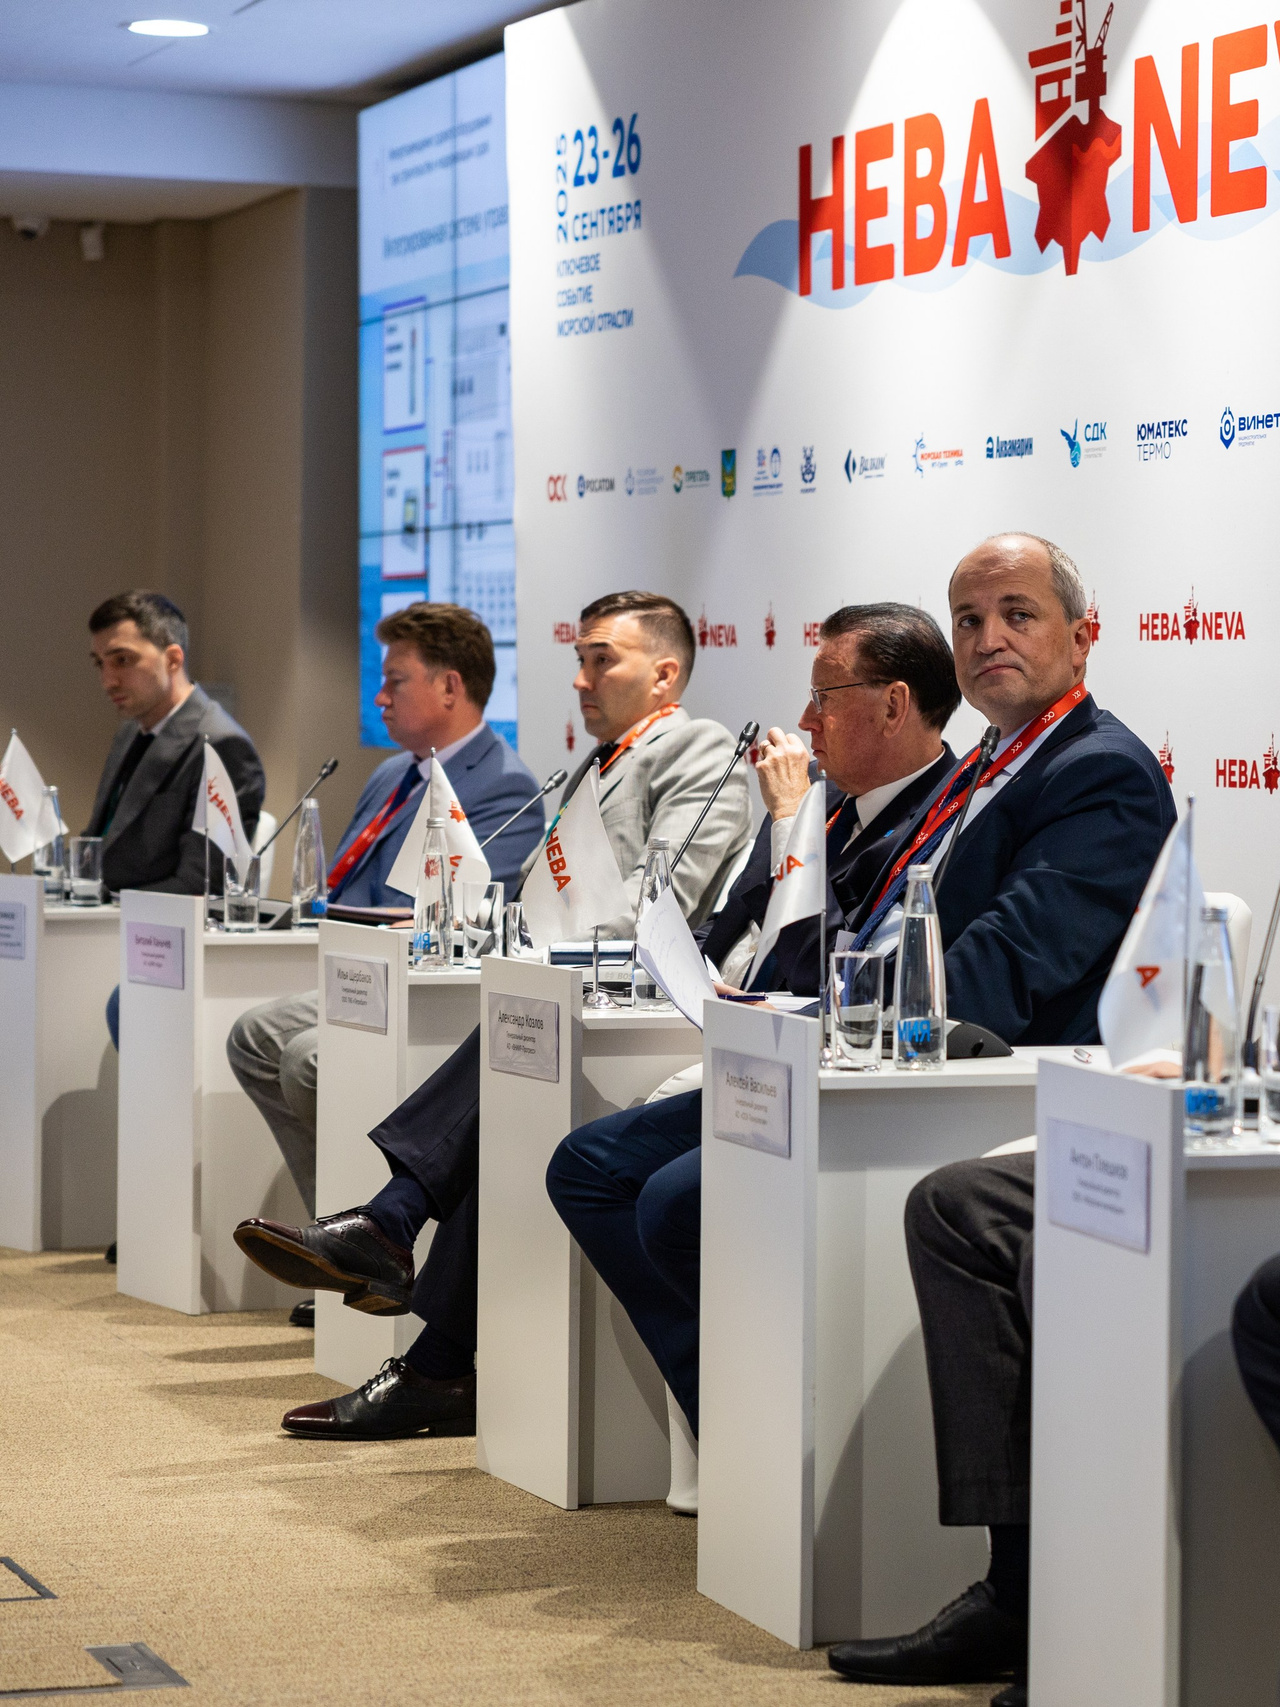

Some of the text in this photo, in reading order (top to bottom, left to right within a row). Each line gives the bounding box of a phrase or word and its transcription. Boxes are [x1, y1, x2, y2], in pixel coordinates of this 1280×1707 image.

[573, 112, 641, 188] 23-26
[555, 133, 568, 244] 2025
[798, 97, 1011, 297] НЕВА
[572, 199, 641, 241] СЕНТЯБРЯ
[557, 253, 601, 278] КЛЮЧЕВОЕ
[557, 285, 593, 307] СОБЫТИЕ
[557, 307, 634, 338] МОРСКОЙ ОТРАСЛИ
[1084, 421, 1107, 442] СДК
[1136, 418, 1188, 441] ЮМАТЕКС
[995, 436, 1033, 459] Аквамарин
[1137, 441, 1171, 462] ТЕРМО
[709, 624, 737, 647] NEVA
[1139, 612, 1181, 641] НЕВА
[1202, 611, 1246, 641] NEVA
[1216, 759, 1260, 789] НЕВА
[498, 1010, 544, 1030] Александр Козлов
[726, 1071, 777, 1098] Алексей Васильев
